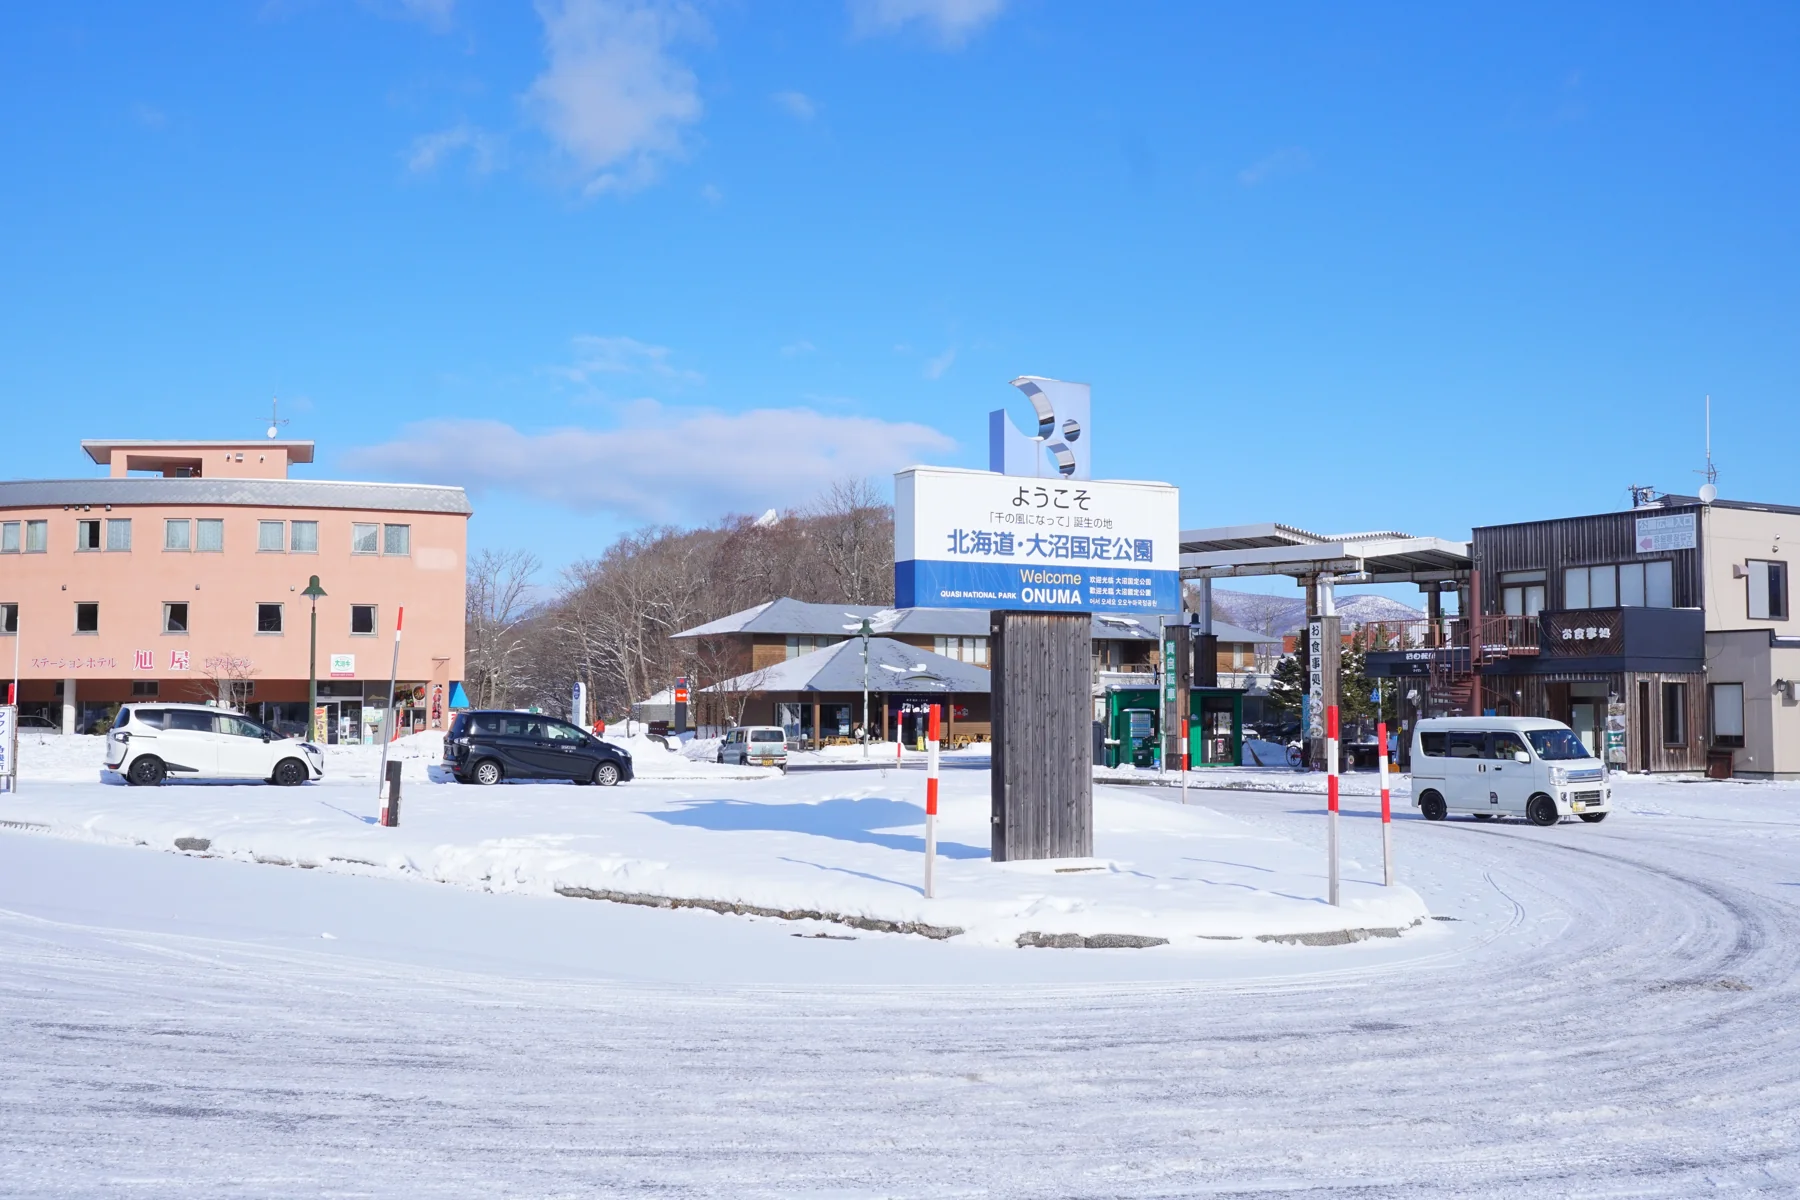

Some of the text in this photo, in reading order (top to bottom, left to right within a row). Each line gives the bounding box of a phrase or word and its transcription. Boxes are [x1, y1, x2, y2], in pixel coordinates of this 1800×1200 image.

[1012, 486, 1091, 510] ようこそ
[947, 528, 1153, 563] 北海道・大沼国定公園
[1020, 569, 1082, 585] Welcome
[940, 590, 1017, 600] QUASI NATIONAL PARK
[1021, 587, 1082, 605] ONUMA
[1561, 627, 1611, 640] お食事処
[31, 649, 253, 671] ステーションホテル 旭屋 レストラン
[1311, 624, 1321, 686] お食事処
